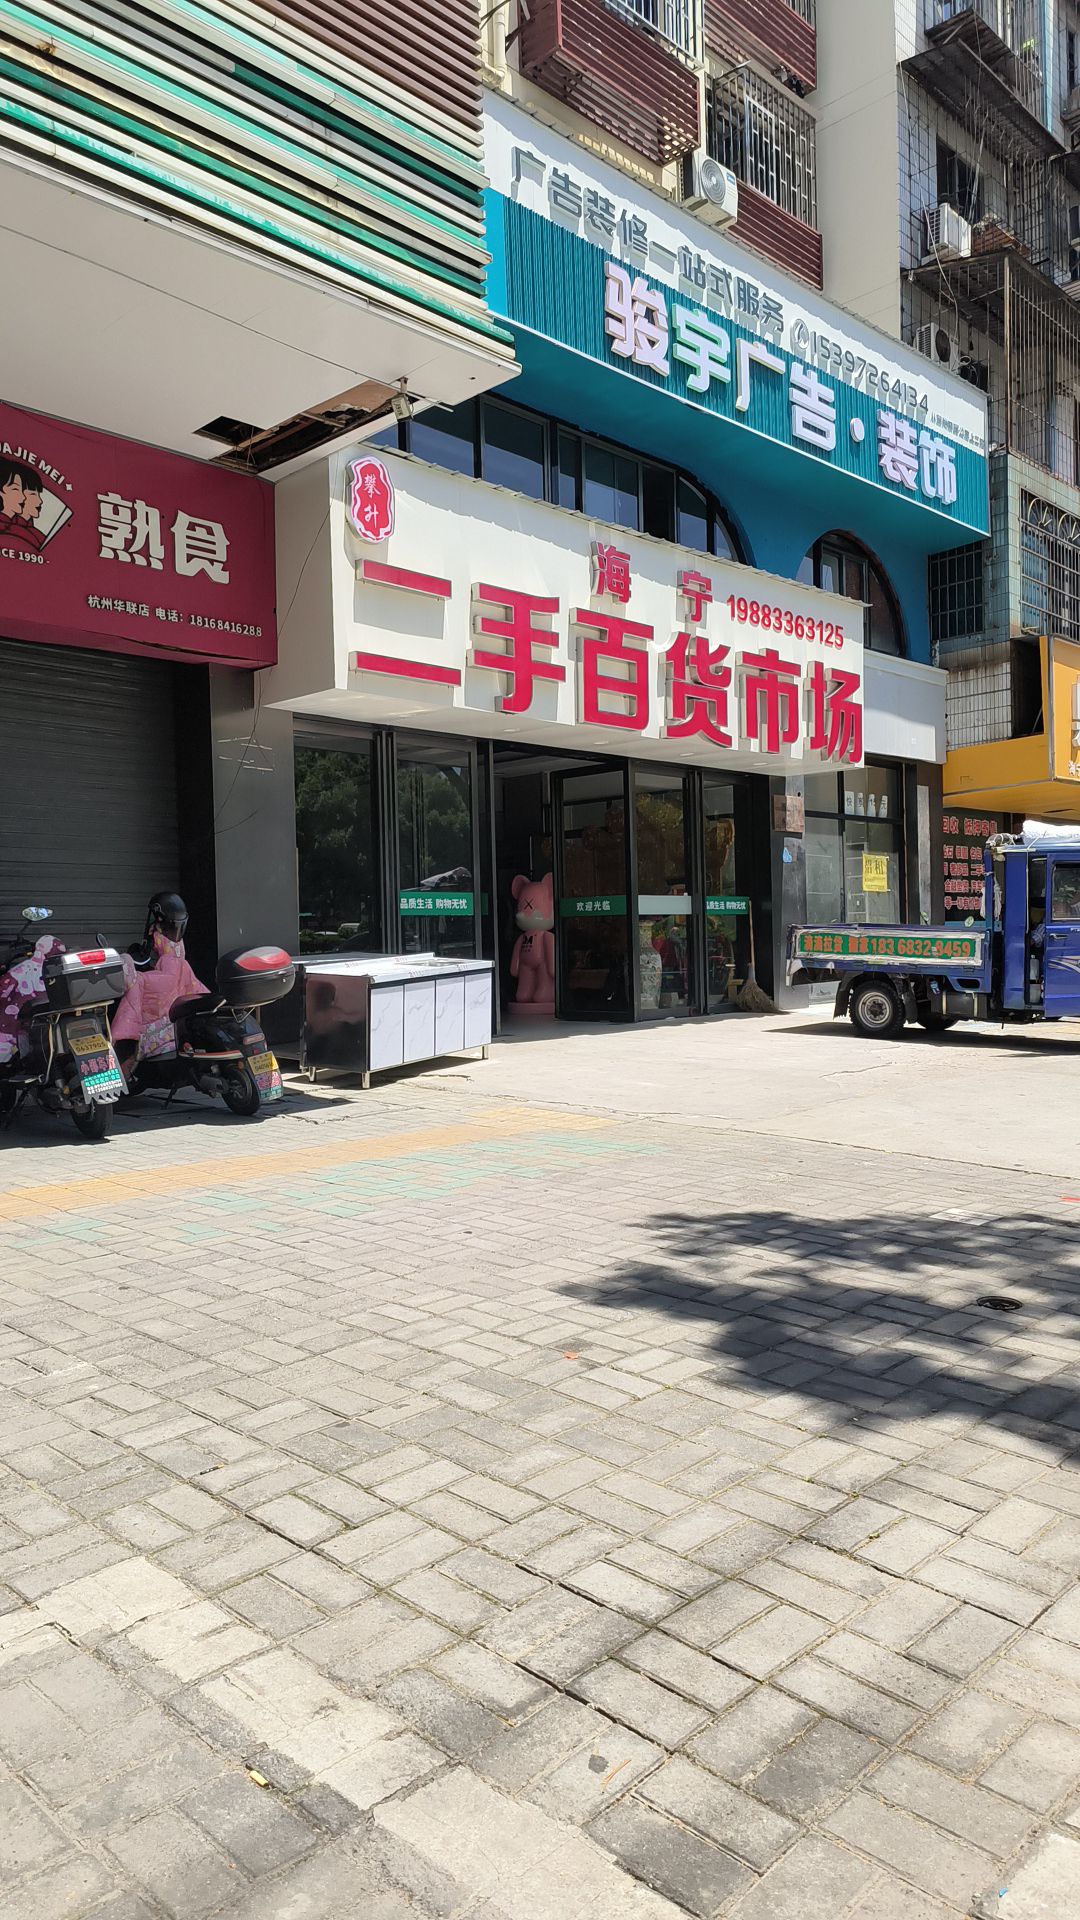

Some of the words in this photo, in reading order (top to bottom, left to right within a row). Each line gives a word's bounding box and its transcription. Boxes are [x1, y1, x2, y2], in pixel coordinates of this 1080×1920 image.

[512, 146, 784, 334] 广告装修一站式服务
[811, 331, 929, 415] 15397264134
[38, 460, 65, 485] MEI
[363, 474, 381, 528] 攀升
[18, 551, 44, 564] 1990
[97, 491, 231, 585] 熟食
[87, 594, 150, 617] 杭州华联店
[592, 541, 713, 622] 海宁
[727, 595, 844, 650] 19883363125
[349, 558, 861, 764] 二手百货市场
[400, 898, 433, 909] 品质生活
[435, 898, 468, 909] 购物无忧
[576, 900, 611, 912] 欢迎光临
